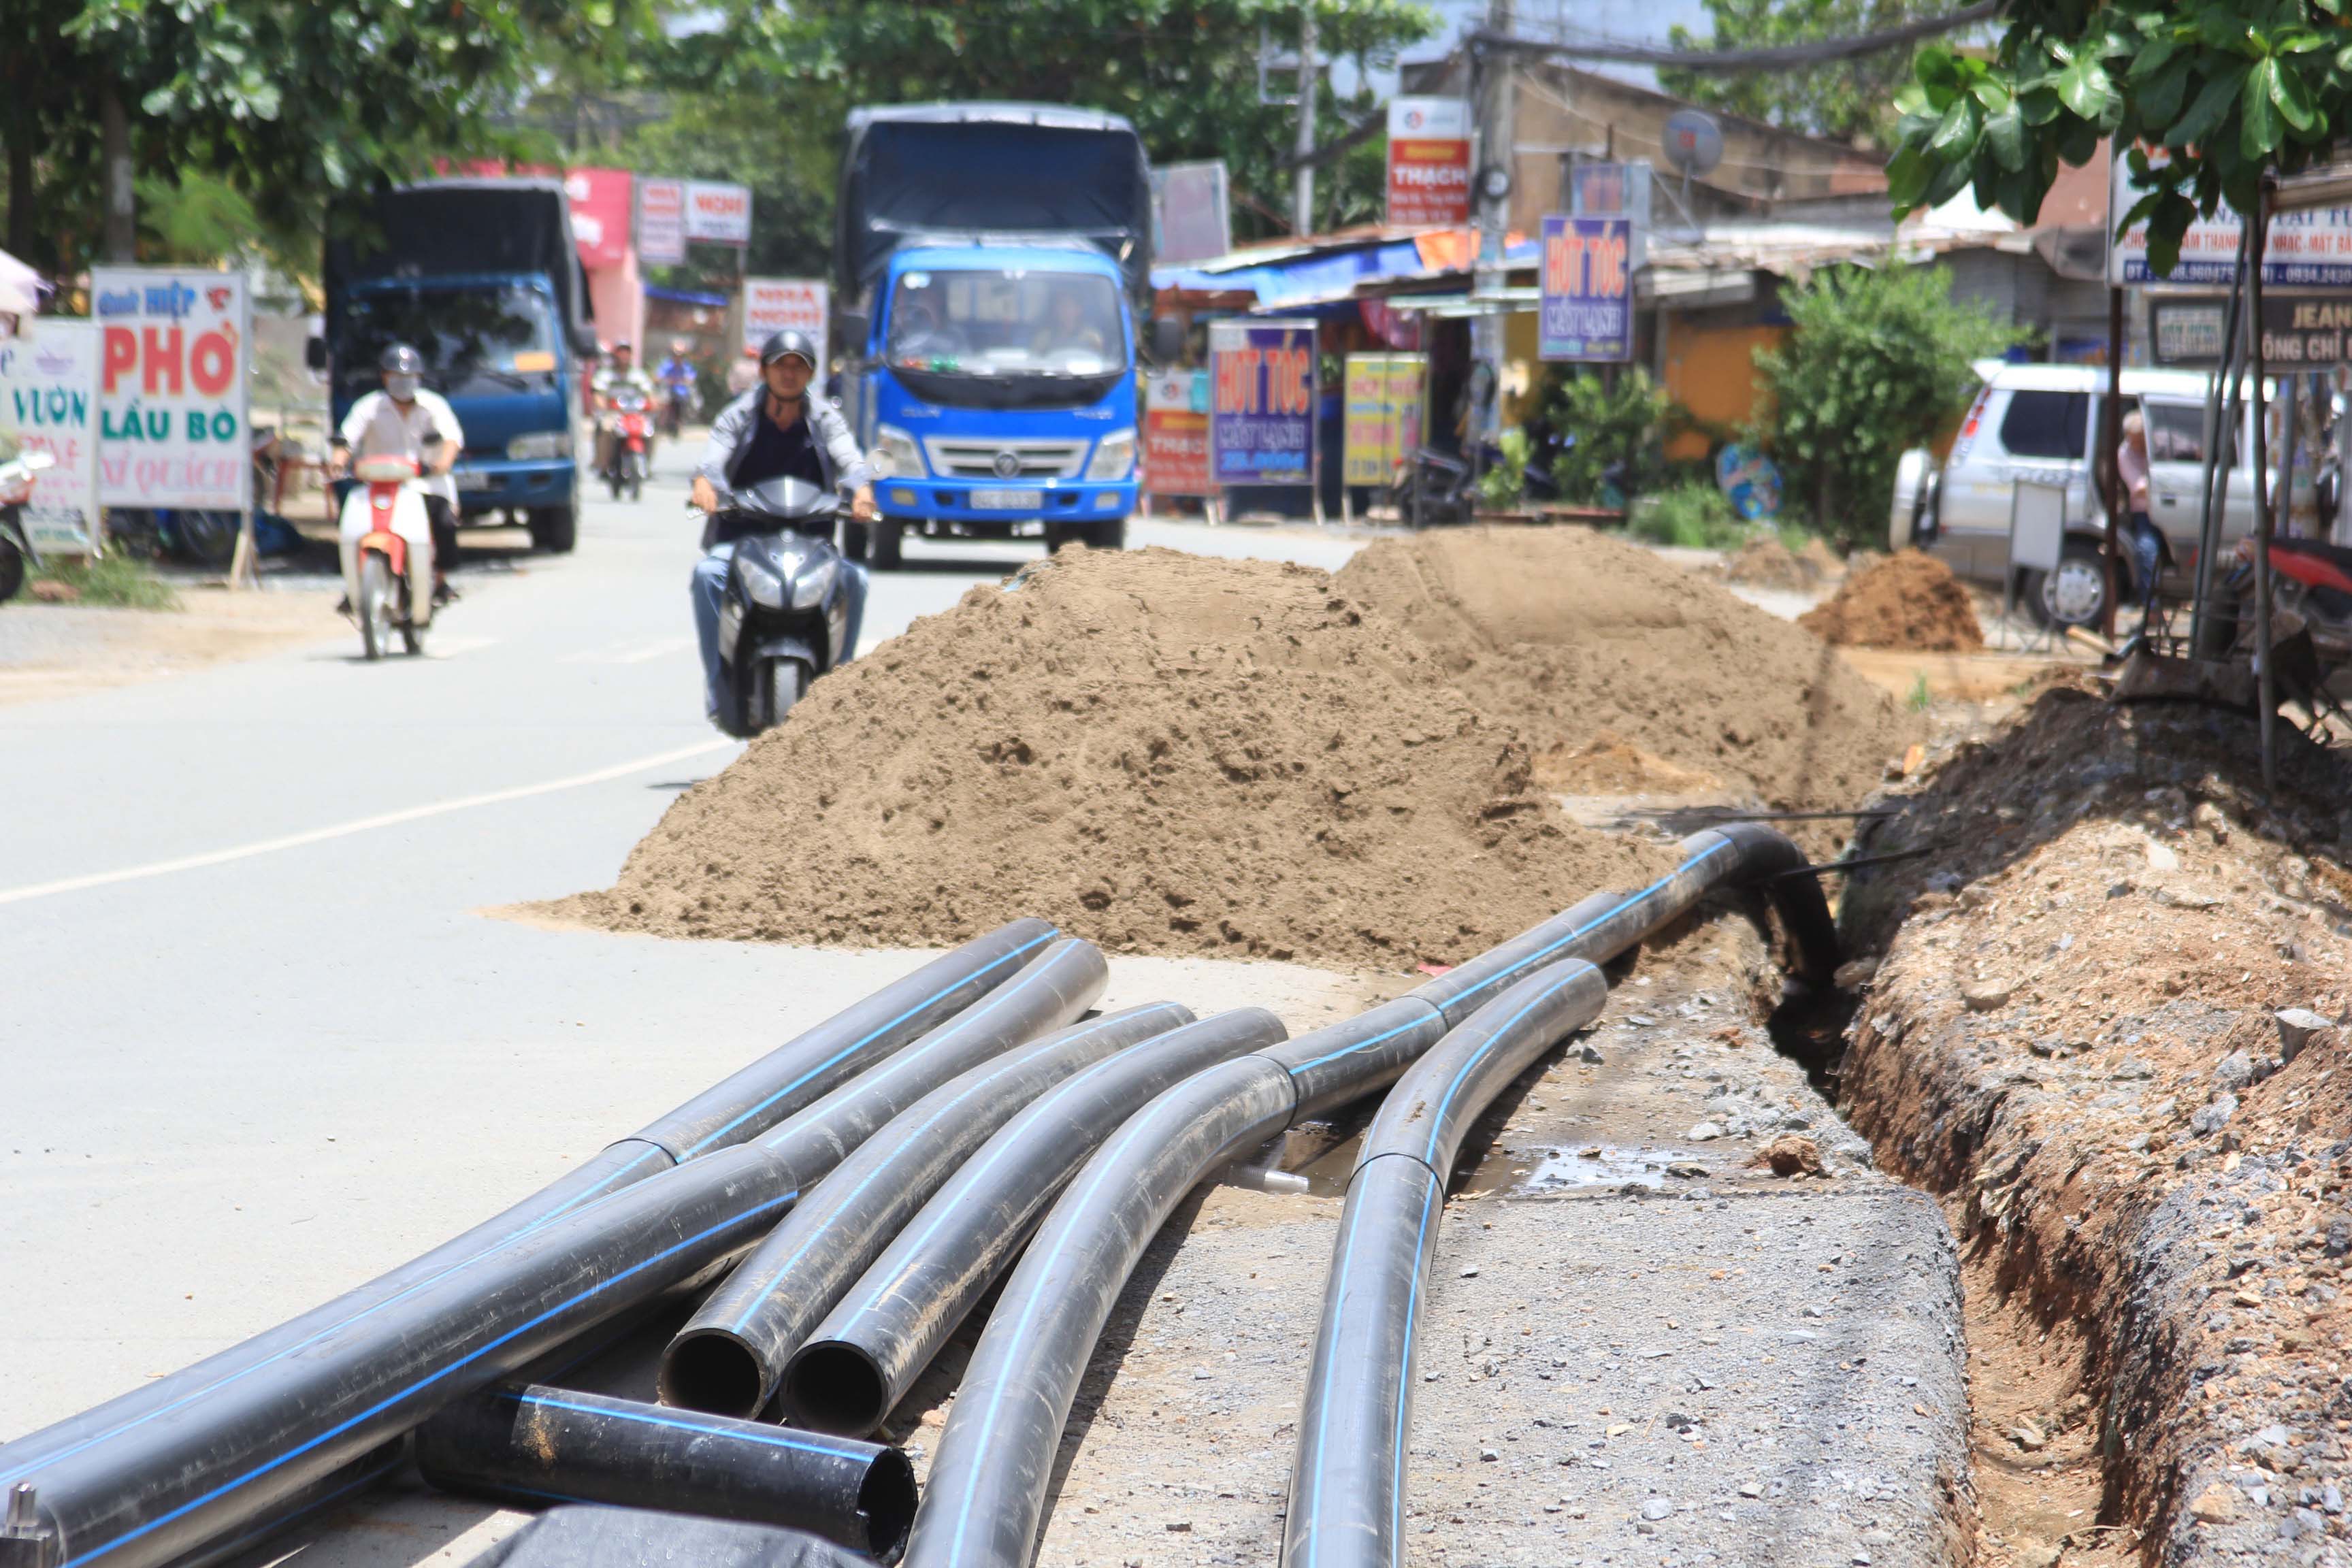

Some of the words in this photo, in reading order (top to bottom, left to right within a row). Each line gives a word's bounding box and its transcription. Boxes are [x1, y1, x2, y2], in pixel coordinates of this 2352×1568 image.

[1393, 167, 1467, 190] THẠCH
[102, 321, 240, 397] PHỞ
[186, 404, 238, 442] BÒ
[1151, 436, 1208, 458] THẠC
